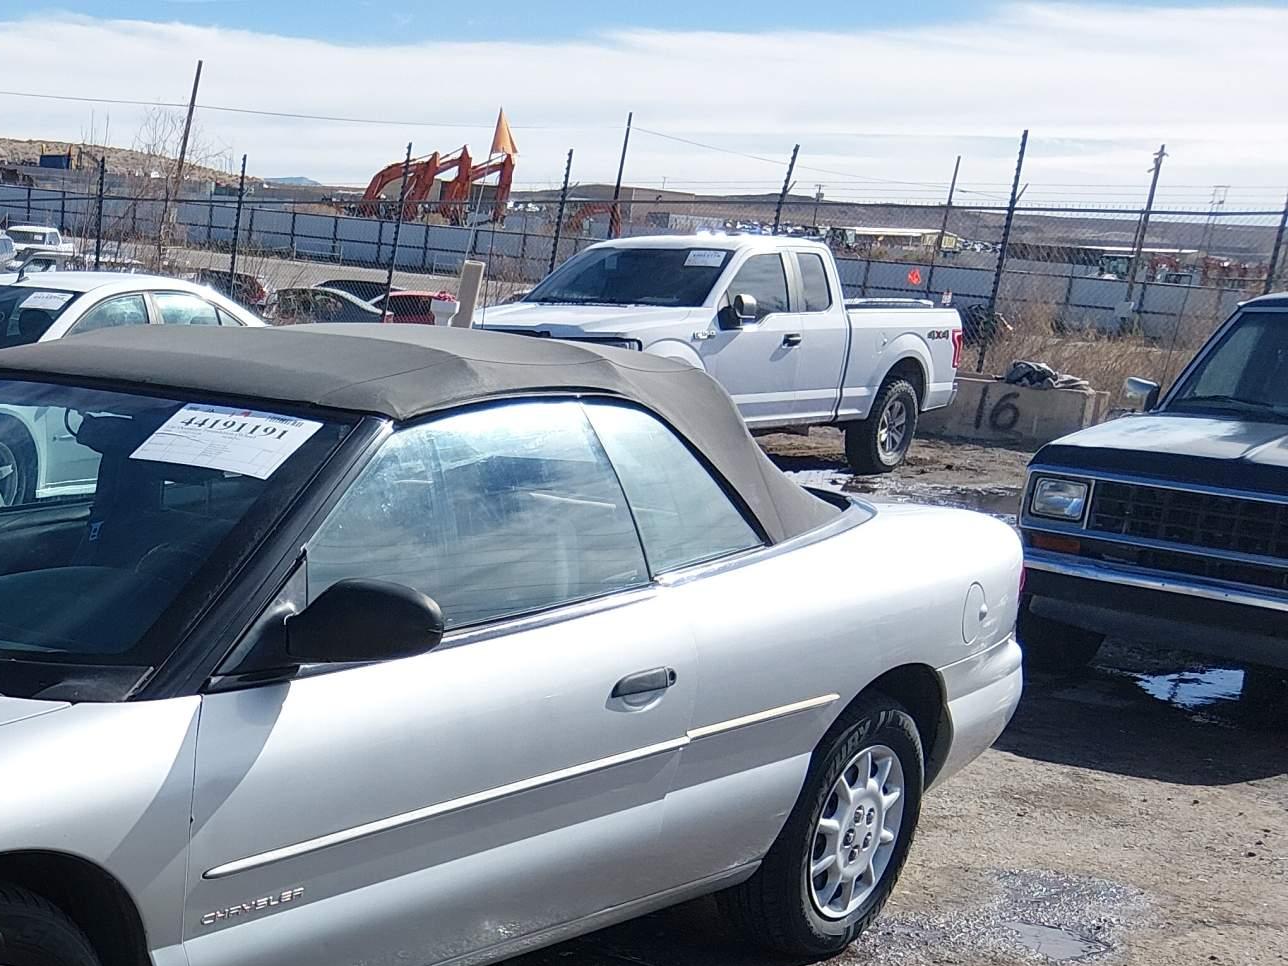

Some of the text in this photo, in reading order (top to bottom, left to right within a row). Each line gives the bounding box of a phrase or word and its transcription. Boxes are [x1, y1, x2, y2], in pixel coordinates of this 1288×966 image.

[974, 383, 1021, 432] 16
[180, 416, 289, 441] 44191191
[200, 887, 305, 926] CHRYSLER
